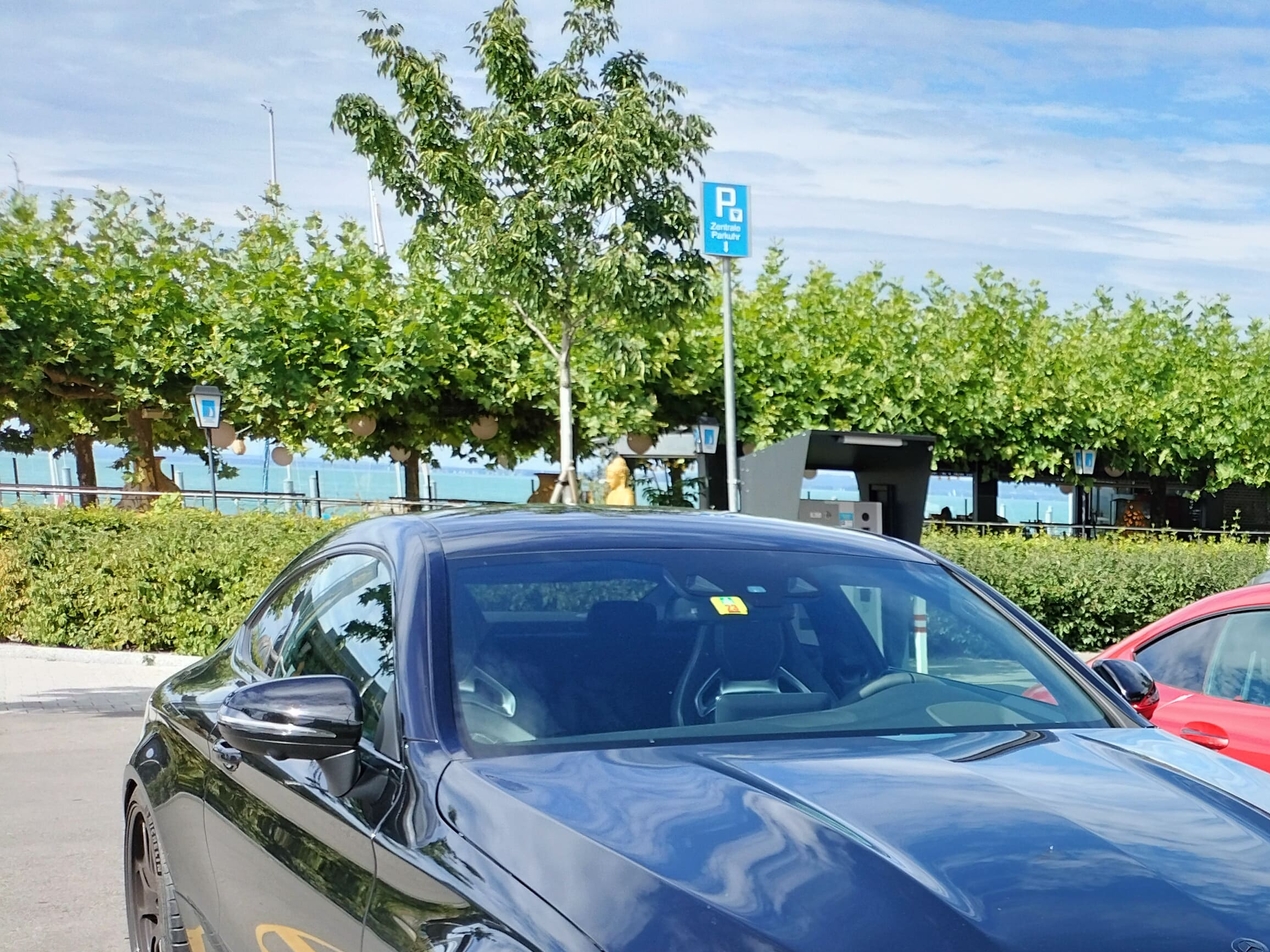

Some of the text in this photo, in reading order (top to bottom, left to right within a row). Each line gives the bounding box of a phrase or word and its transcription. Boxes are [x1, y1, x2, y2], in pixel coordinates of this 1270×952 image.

[716, 186, 736, 217] P
[710, 222, 741, 232] Zentrale
[711, 231, 741, 241] Parkuhr
